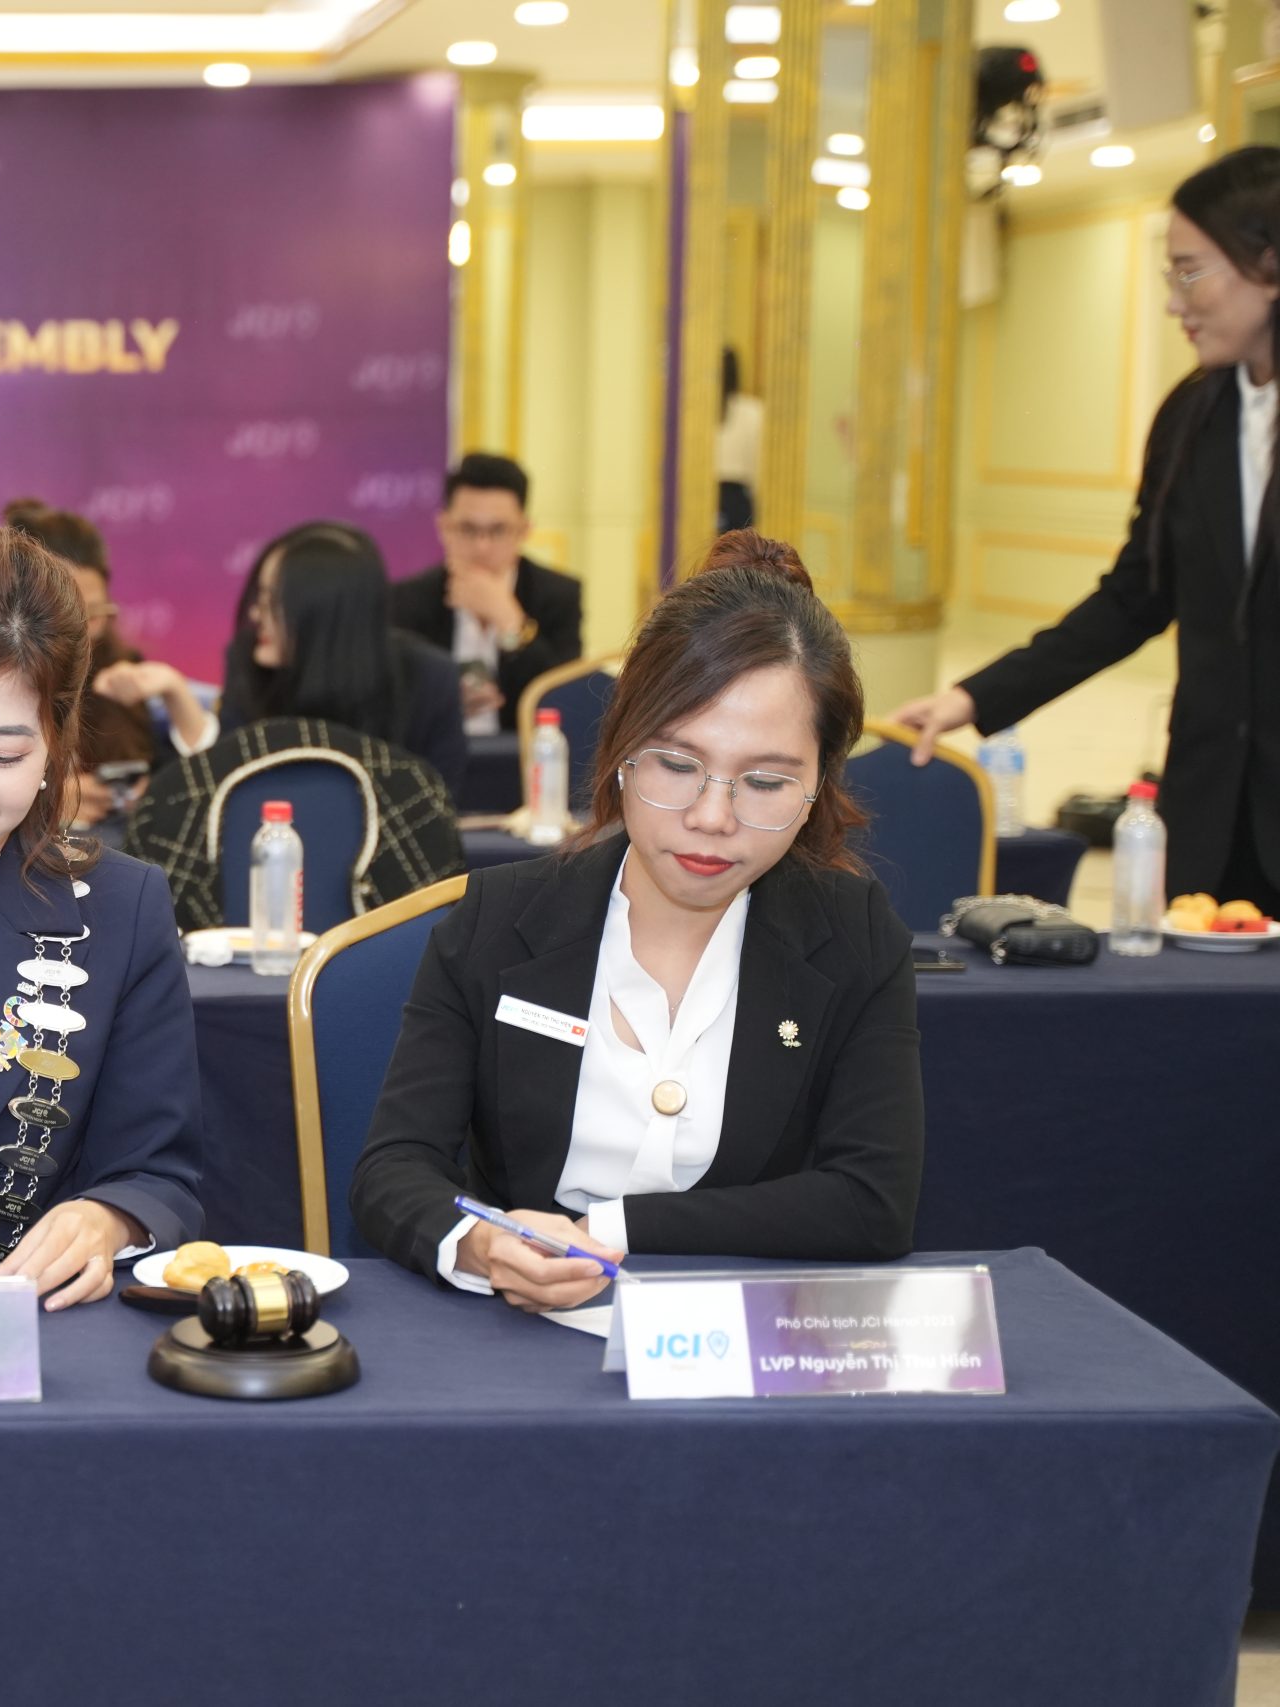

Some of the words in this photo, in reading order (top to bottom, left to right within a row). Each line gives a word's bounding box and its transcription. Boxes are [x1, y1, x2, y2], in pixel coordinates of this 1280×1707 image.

[5, 1203, 17, 1211] JCI
[776, 1316, 801, 1330] Phó
[804, 1314, 830, 1329] Chủ
[833, 1315, 858, 1331] tịch
[861, 1316, 880, 1329] JCI
[646, 1333, 701, 1359] JCI
[759, 1355, 795, 1372] LVP
[800, 1352, 867, 1374] Nguyễn
[872, 1353, 899, 1374] Thị
